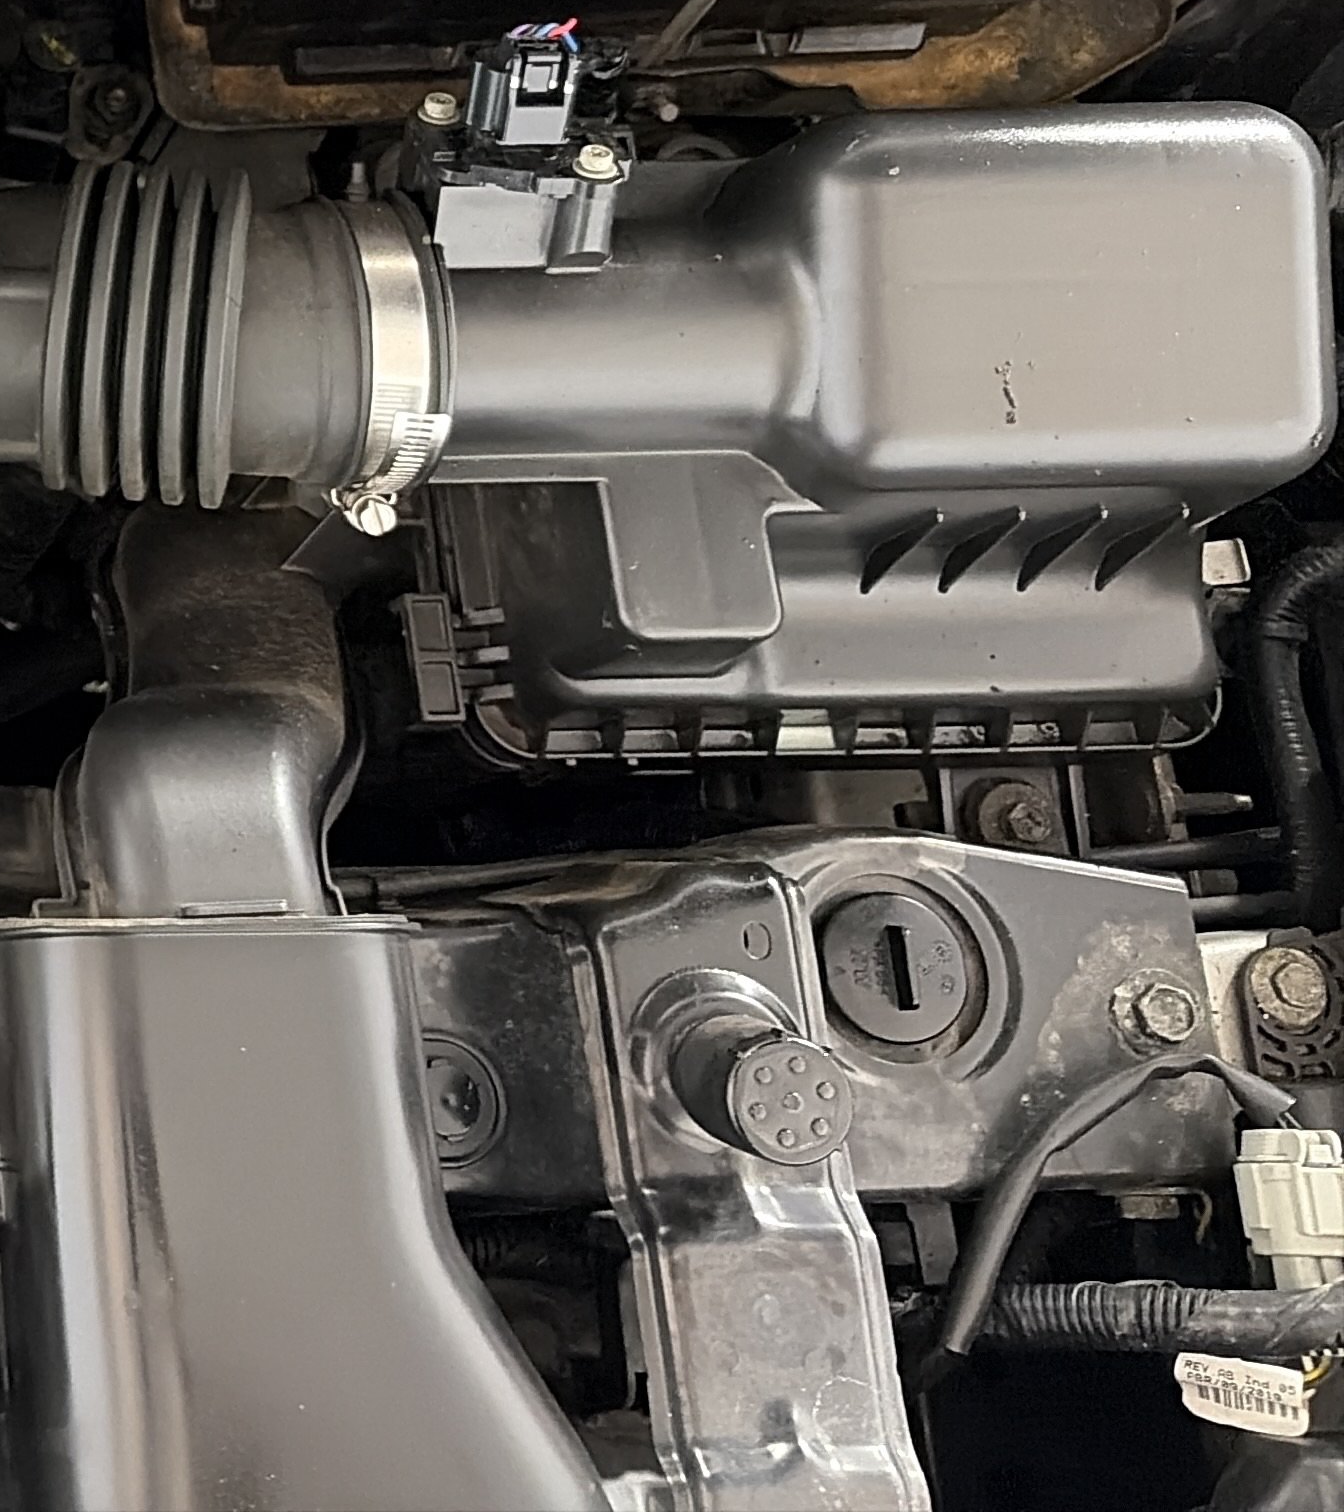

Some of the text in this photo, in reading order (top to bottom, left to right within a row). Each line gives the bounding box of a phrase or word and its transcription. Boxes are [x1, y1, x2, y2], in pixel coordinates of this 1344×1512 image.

[1183, 1360, 1209, 1373] REV
[1245, 1375, 1270, 1389] Ind
[1279, 1383, 1296, 1395] 05
